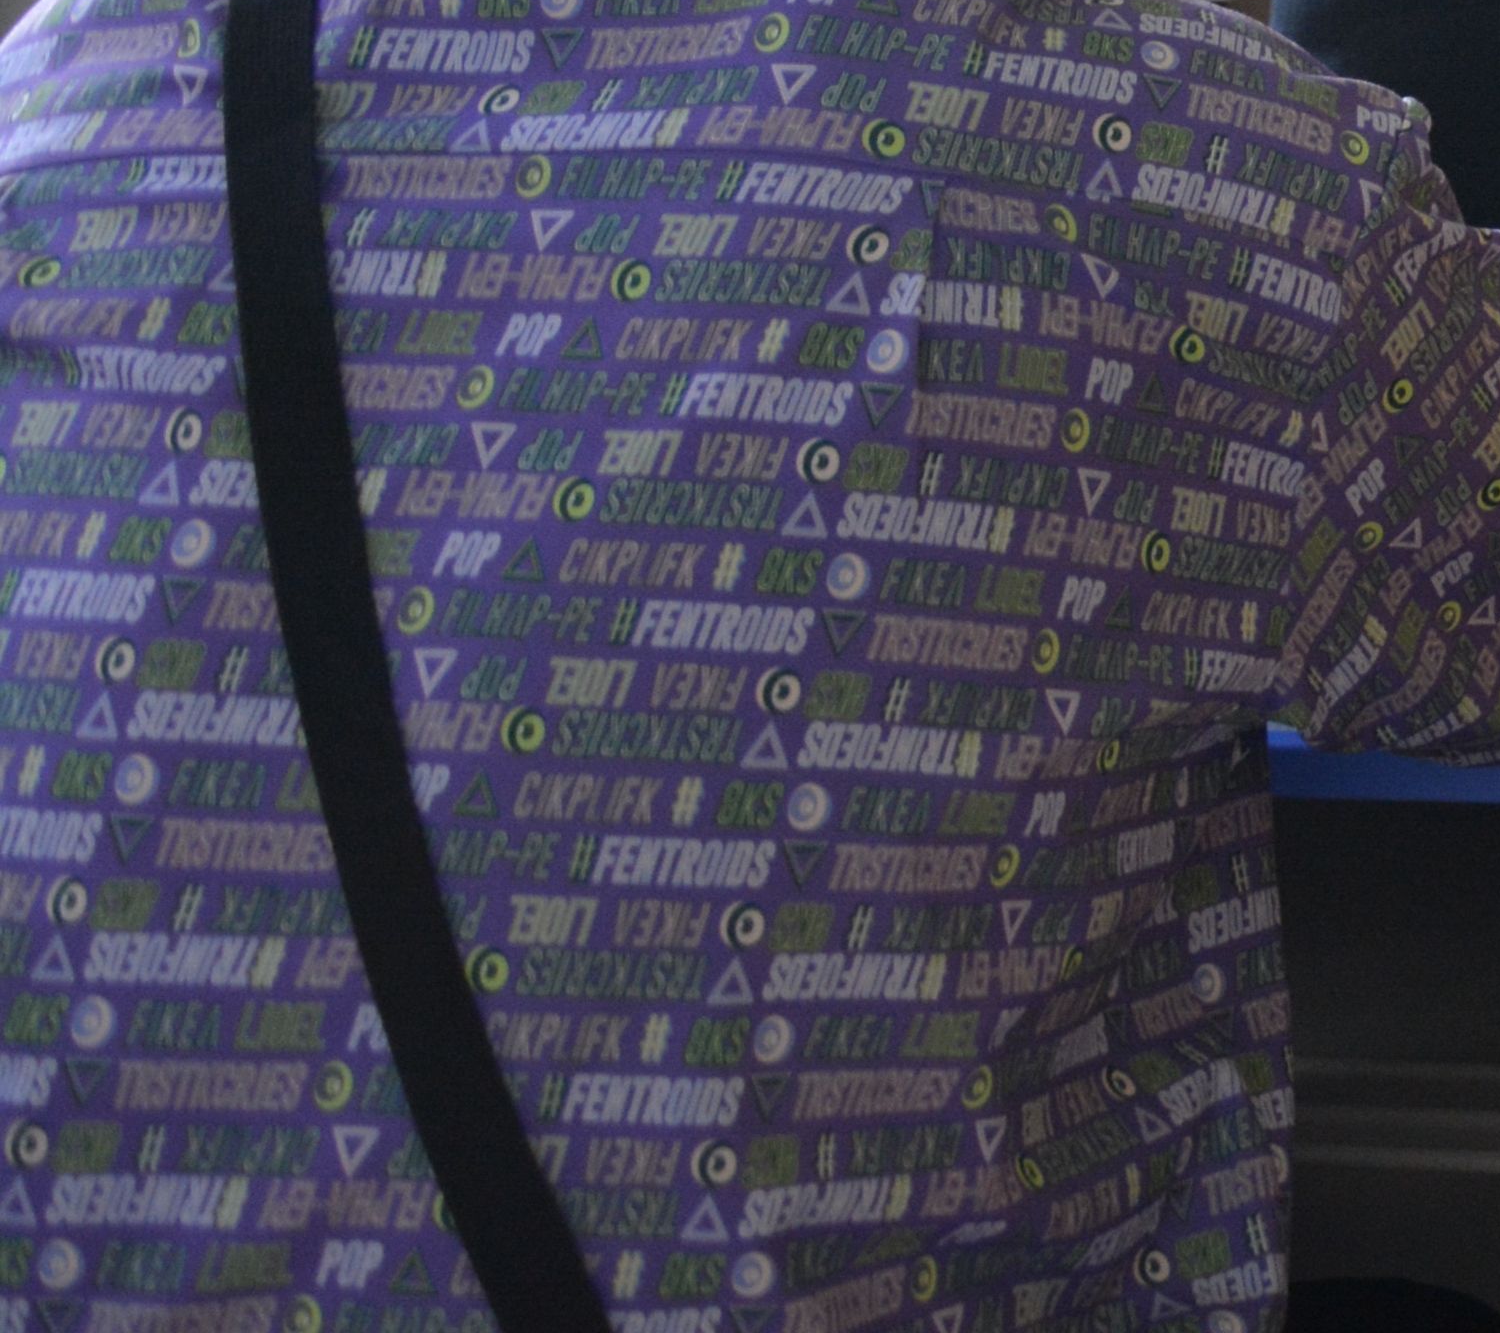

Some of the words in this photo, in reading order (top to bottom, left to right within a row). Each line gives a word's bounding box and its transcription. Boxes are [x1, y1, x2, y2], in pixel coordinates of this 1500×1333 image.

[821, 76, 887, 114] POP
[1356, 105, 1401, 136] POP
[573, 213, 641, 255] POP
[494, 311, 563, 357] POP
[1084, 356, 1135, 406] POP
[518, 428, 584, 473] POP
[1113, 479, 1161, 524] POP
[1344, 457, 1386, 517] POP
[432, 530, 502, 578] POP
[1057, 574, 1108, 623] POP
[1430, 550, 1474, 598] POP
[459, 654, 529, 703] POP
[315, 1238, 386, 1290] POP
